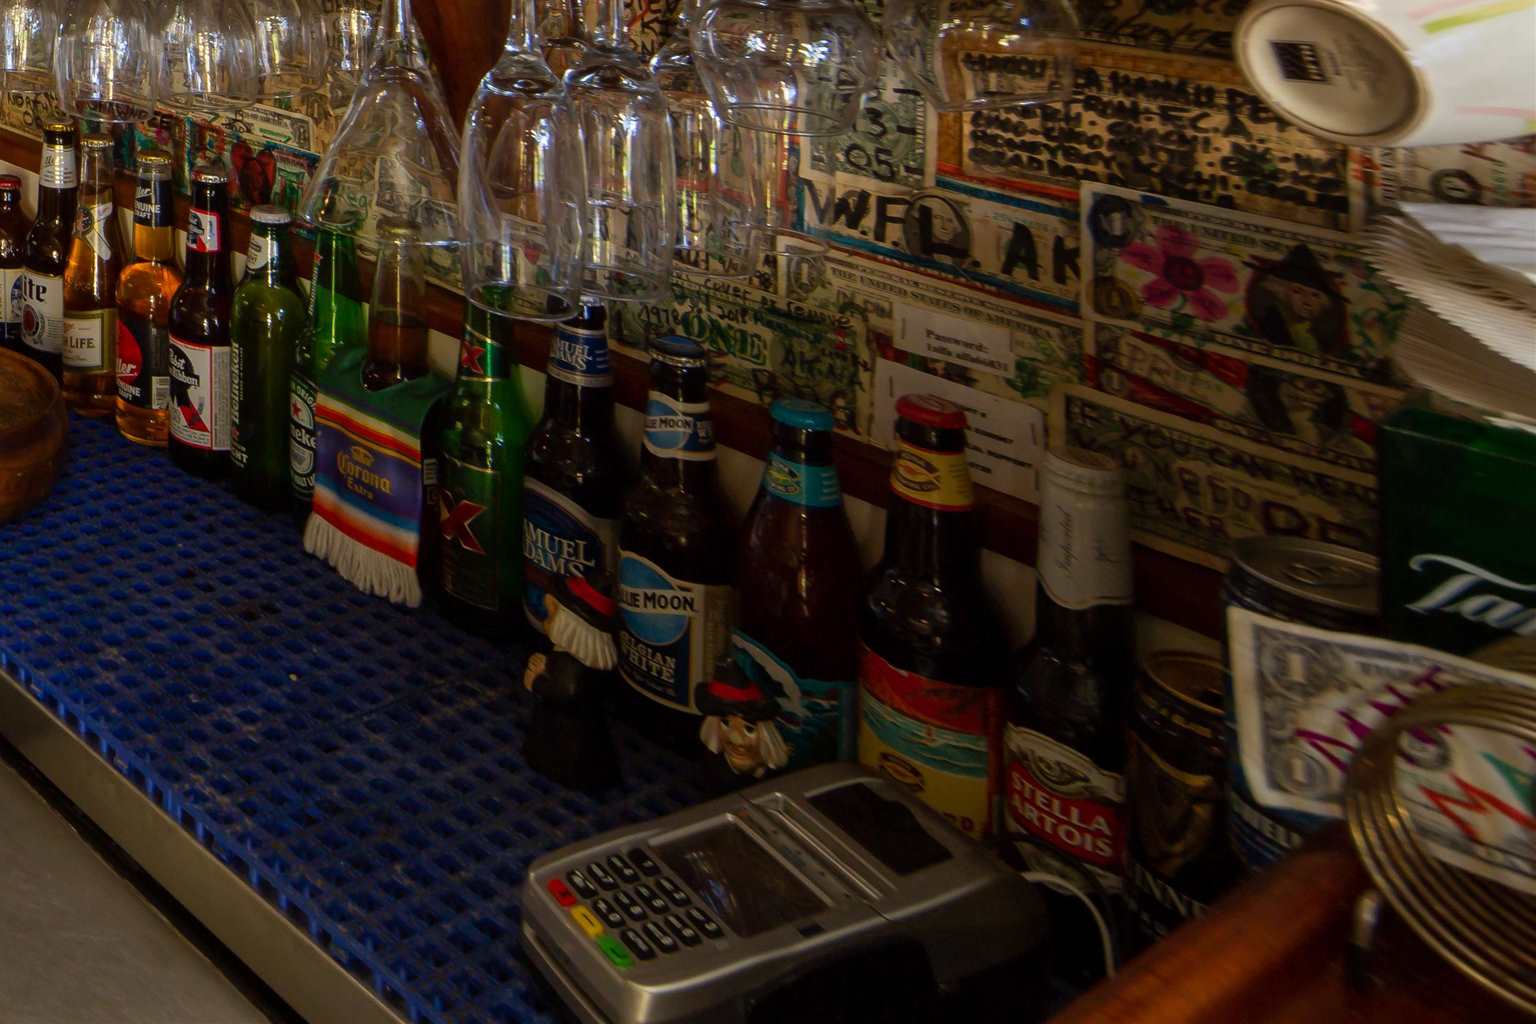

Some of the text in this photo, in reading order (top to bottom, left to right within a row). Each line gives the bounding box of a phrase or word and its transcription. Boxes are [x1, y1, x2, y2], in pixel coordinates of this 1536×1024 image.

[69, 336, 95, 349] LIFE
[658, 416, 693, 430] MOON
[335, 447, 393, 496] Corona
[346, 478, 375, 502] Extra
[643, 591, 696, 613] MOON
[1009, 770, 1112, 836] STELLA
[1009, 794, 1115, 858] ARTOIS
